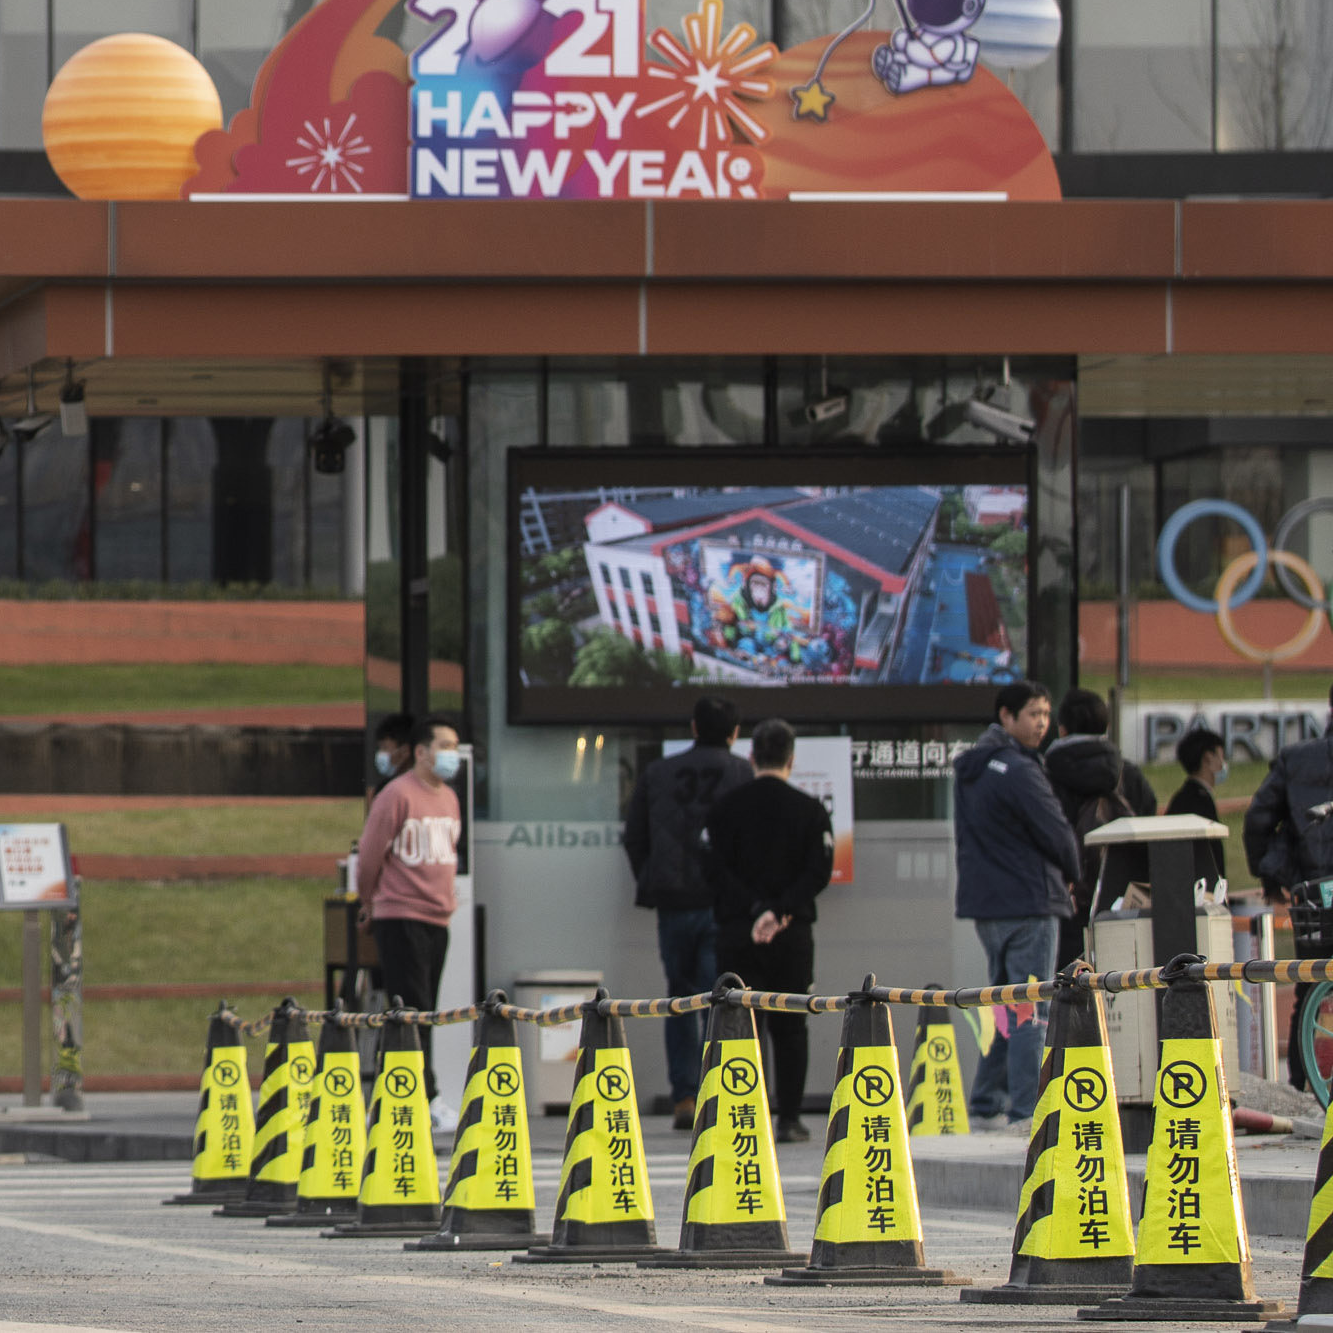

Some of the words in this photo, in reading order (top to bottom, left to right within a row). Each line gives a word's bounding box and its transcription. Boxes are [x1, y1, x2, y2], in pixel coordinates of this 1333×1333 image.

[416, 90, 638, 139] HAPPY
[417, 148, 572, 196] NEW
[583, 150, 759, 199] YEAR
[219, 1093, 242, 1171] 请勿泊车
[330, 1104, 353, 1191] 请勿泊车
[392, 1105, 416, 1197] 请勿泊车
[493, 1103, 519, 1202] 请勿泊车
[604, 1109, 638, 1214] 请勿泊车
[729, 1103, 764, 1215] 请勿泊车
[861, 1115, 896, 1234] 请勿泊车
[1071, 1121, 1111, 1250] 请勿泊车
[1165, 1118, 1202, 1256] 请勿泊车
